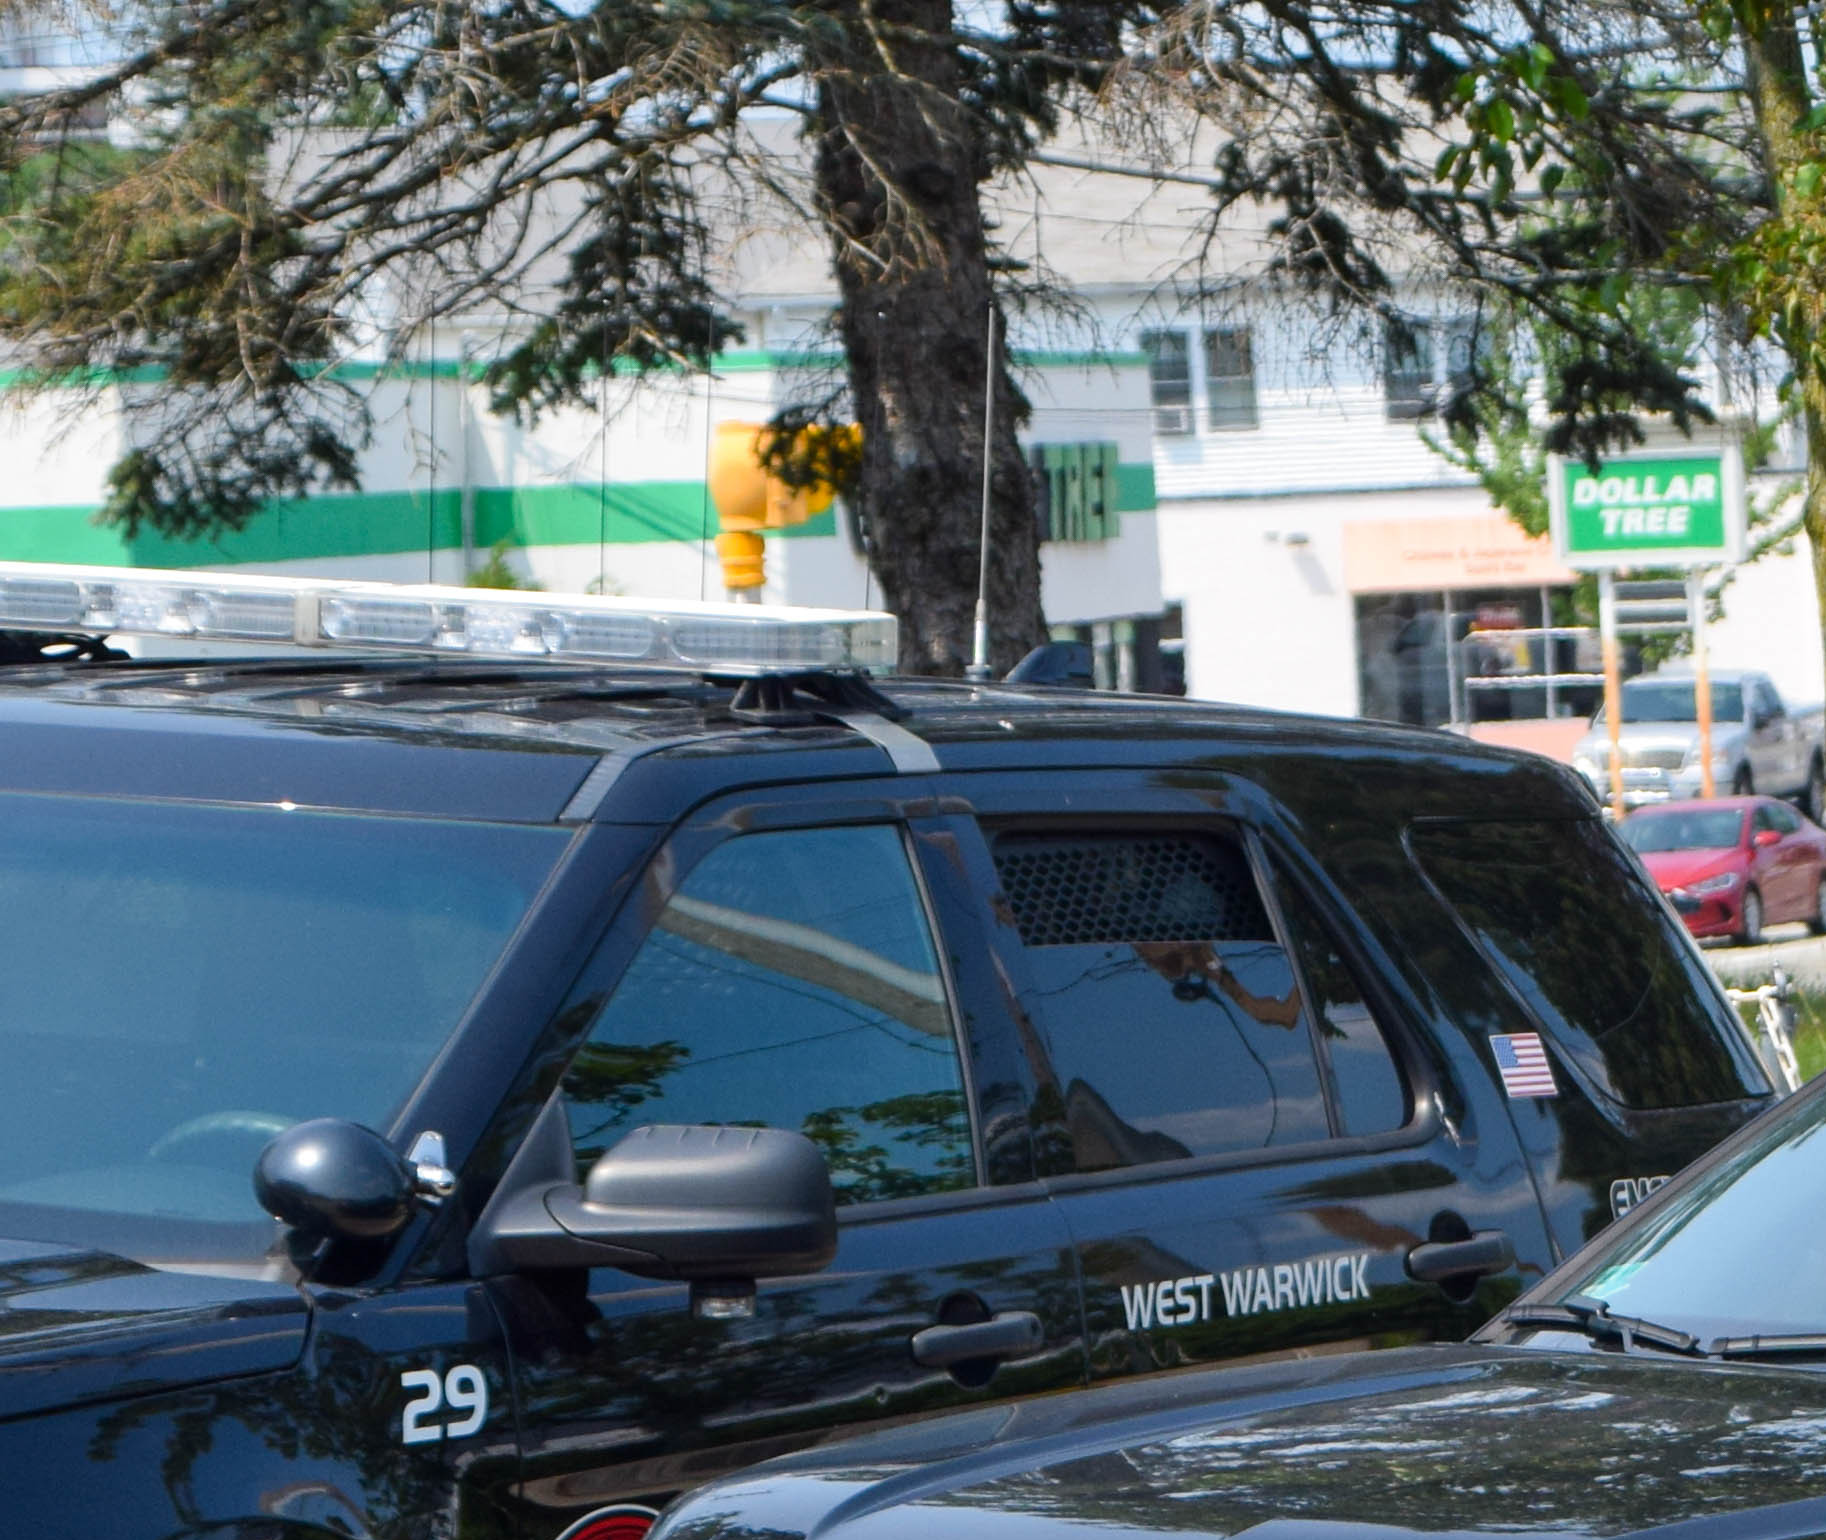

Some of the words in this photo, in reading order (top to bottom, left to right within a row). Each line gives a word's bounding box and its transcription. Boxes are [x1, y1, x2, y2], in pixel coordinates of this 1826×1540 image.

[1572, 473, 1717, 505] DOLLAR
[1598, 504, 1691, 536] TREE
[1121, 1274, 1215, 1331] WEST
[1220, 1253, 1373, 1318] WARWICK
[401, 1363, 488, 1445] 29
